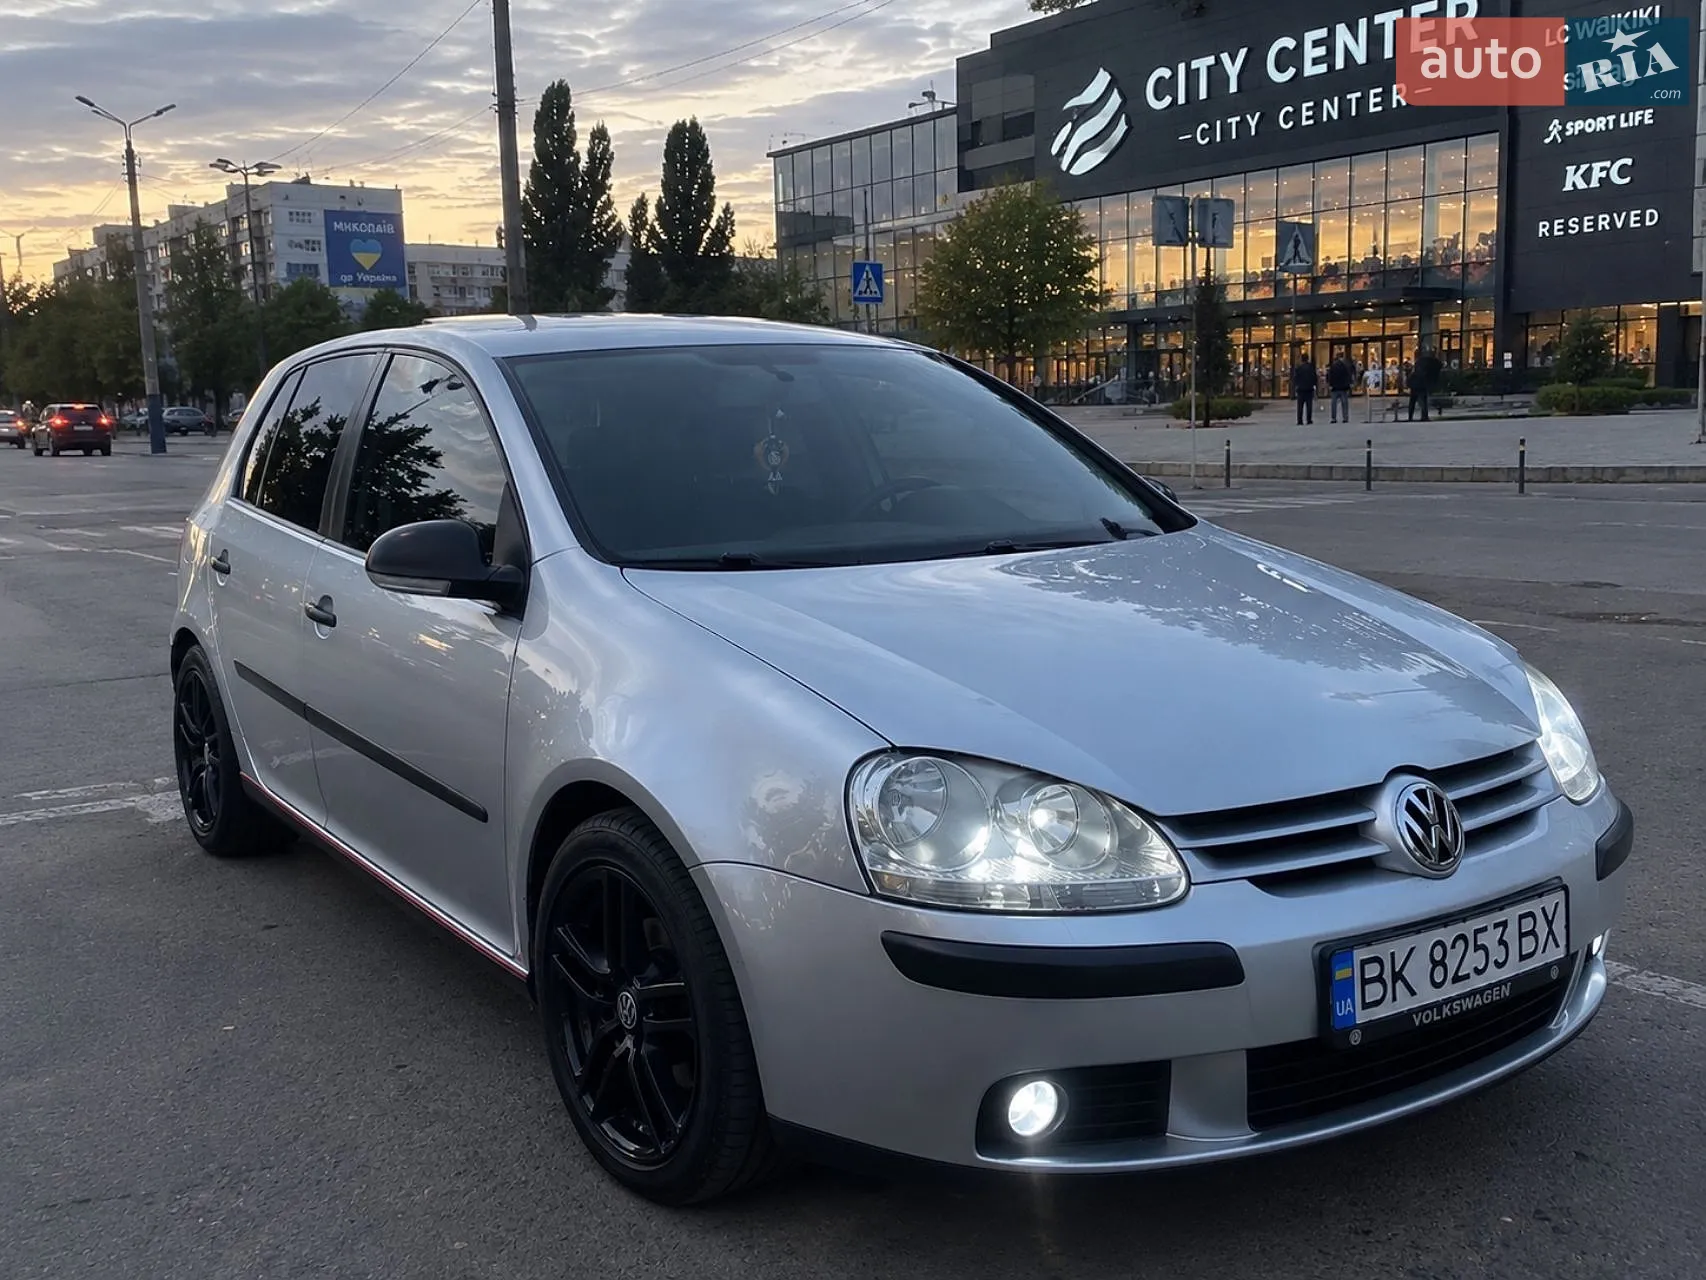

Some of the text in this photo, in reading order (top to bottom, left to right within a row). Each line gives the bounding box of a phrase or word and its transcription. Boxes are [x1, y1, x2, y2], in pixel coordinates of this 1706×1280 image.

[1145, 0, 1479, 111] CITY CENTER
[1195, 83, 1408, 146] CITY CENTER
[1564, 108, 1654, 136] SPORT LIFE
[1562, 157, 1633, 192] KFC
[1537, 208, 1659, 238] RESERVED
[1359, 900, 1561, 1011] BK 8253 BX
[1335, 1000, 1354, 1017] UA
[1412, 982, 1512, 1027] VOLKSWAGEN
